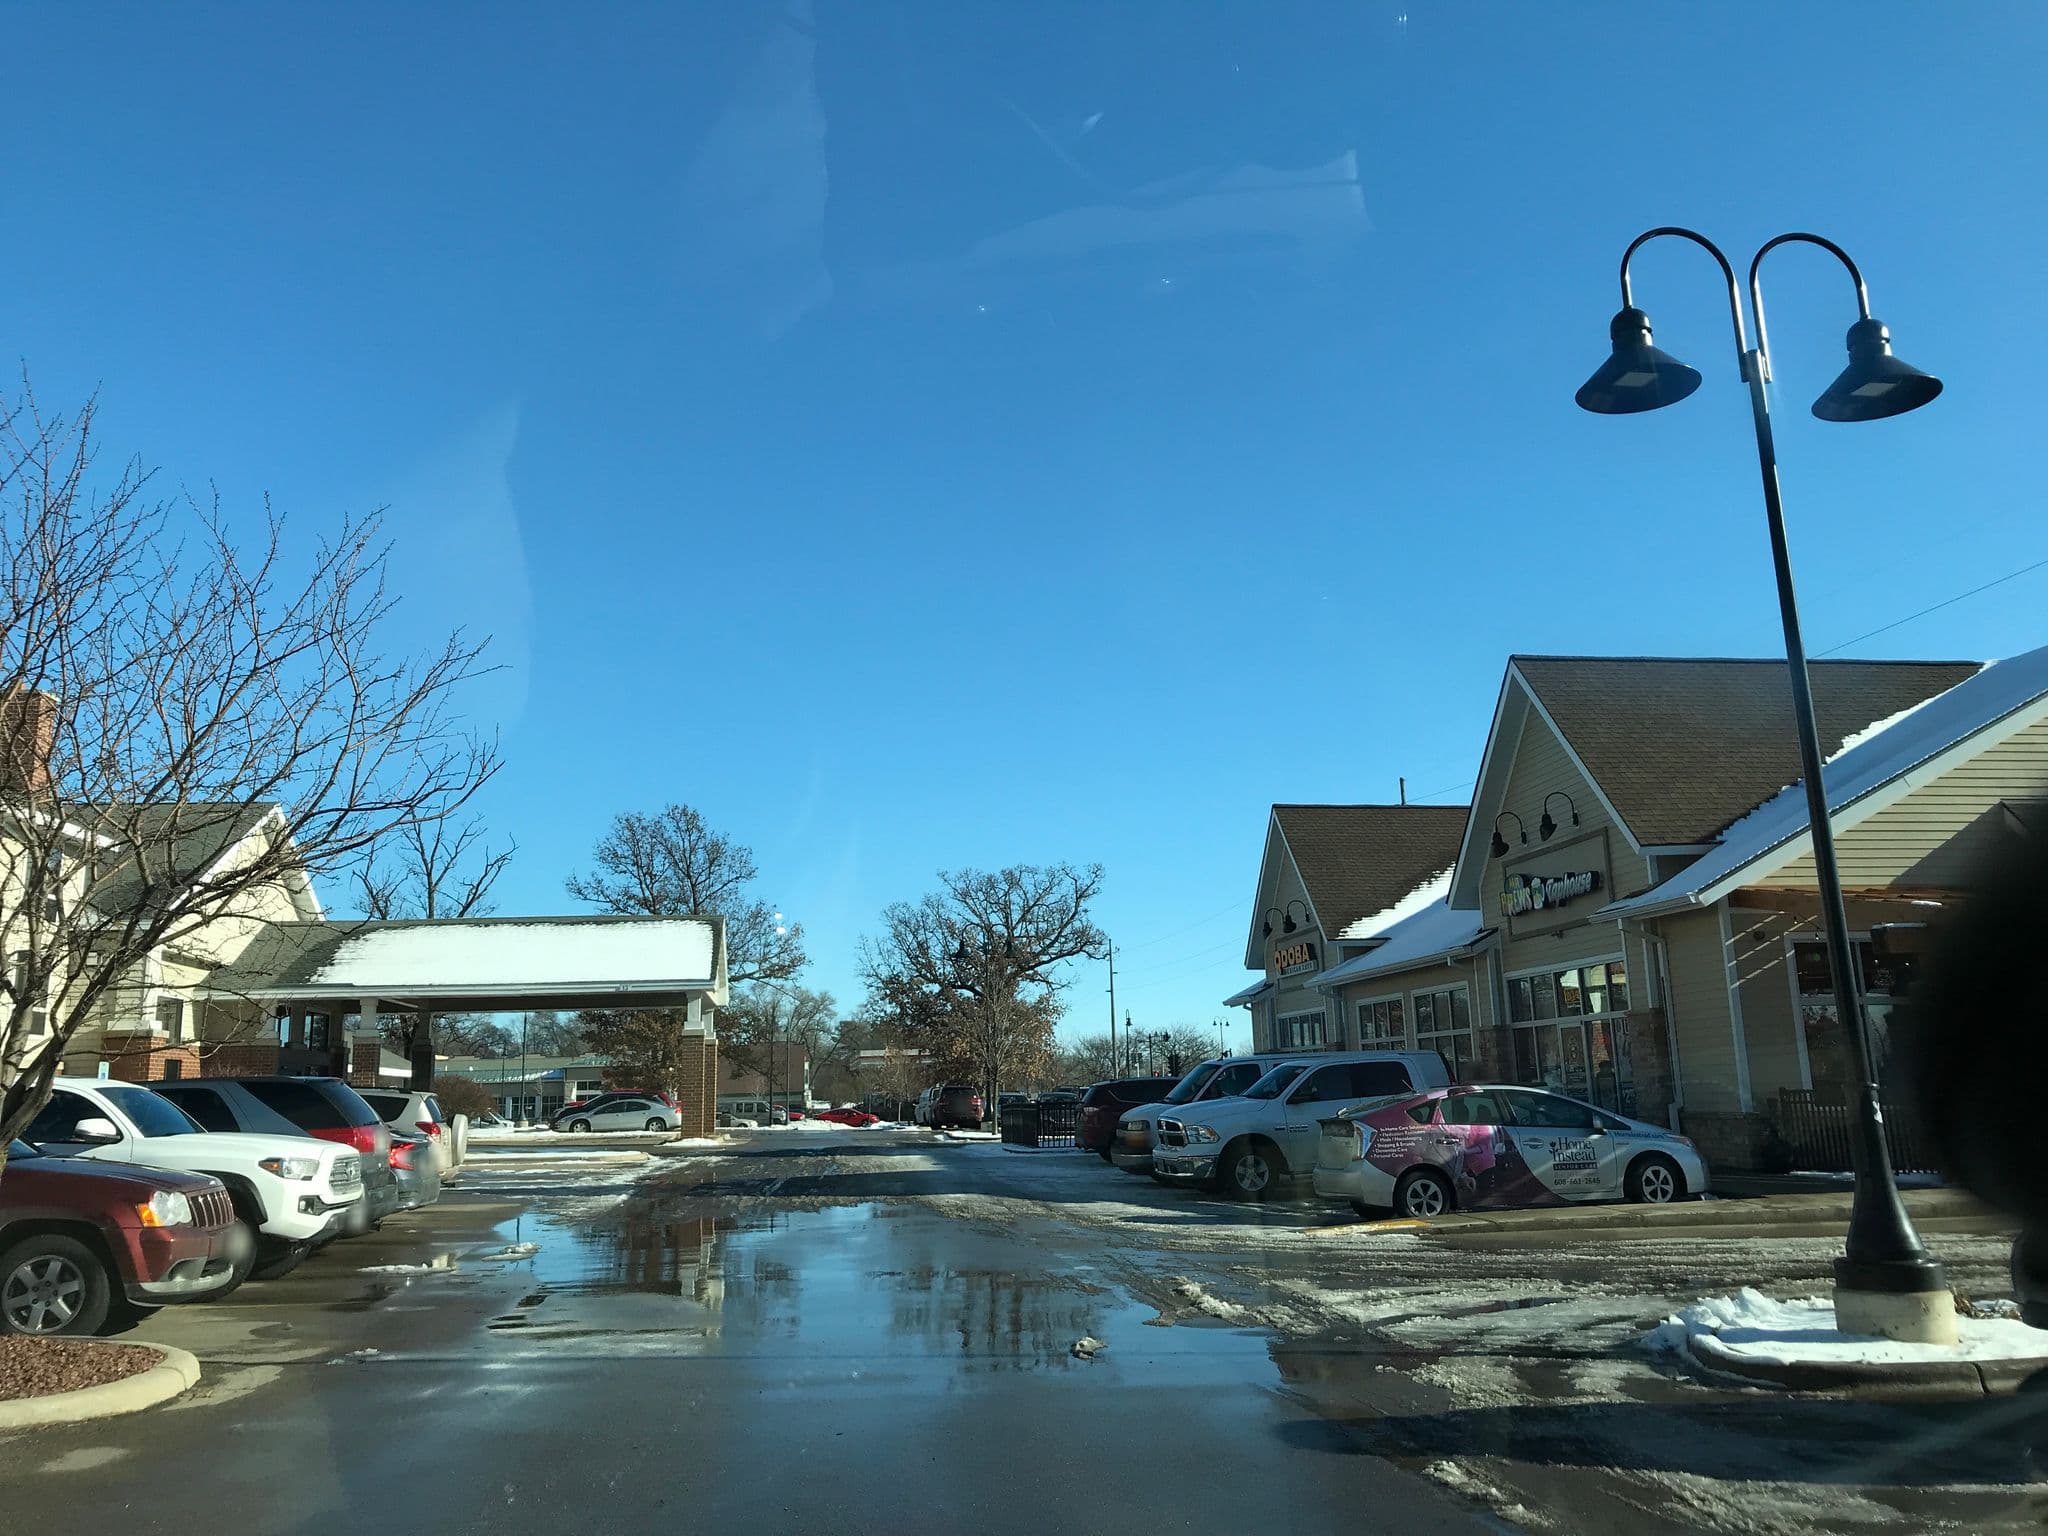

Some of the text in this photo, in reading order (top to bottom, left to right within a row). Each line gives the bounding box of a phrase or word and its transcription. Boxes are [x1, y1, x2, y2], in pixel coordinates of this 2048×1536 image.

[1274, 943, 1310, 974] QDOBA
[1558, 1136, 1593, 1150] Home
[1552, 1147, 1596, 1162] Instead
